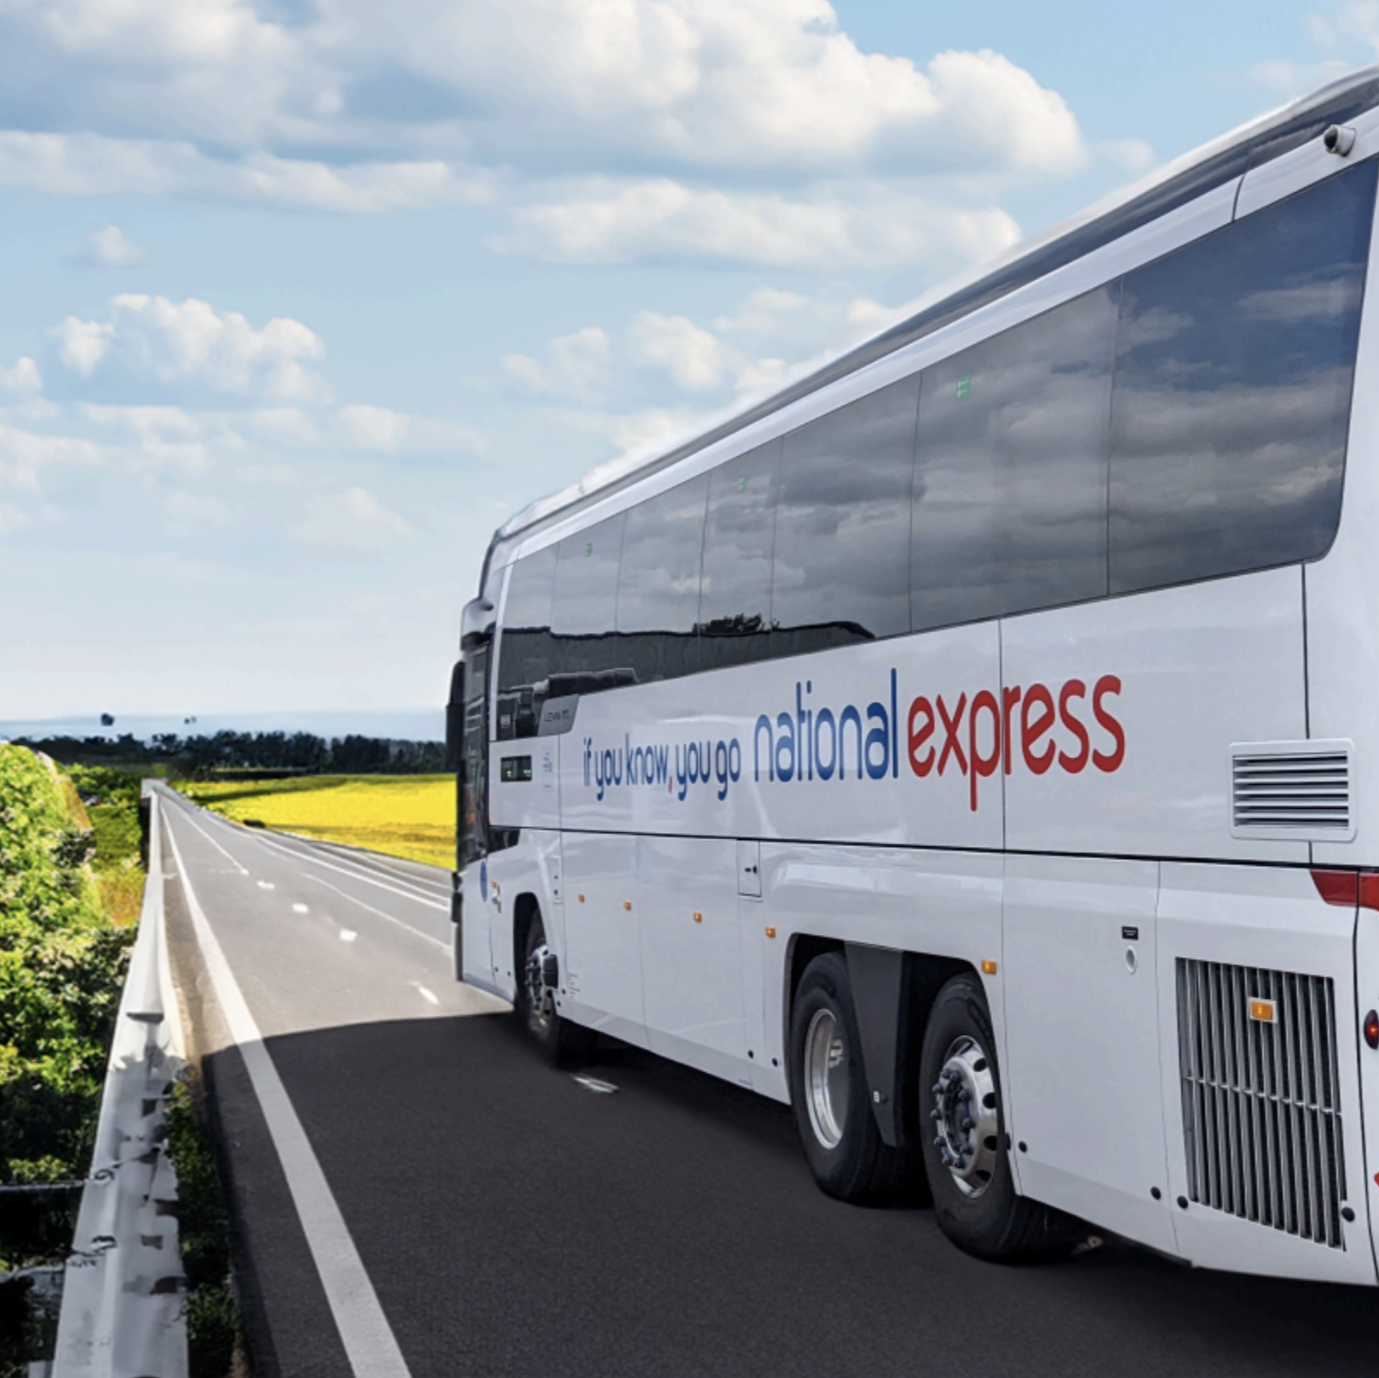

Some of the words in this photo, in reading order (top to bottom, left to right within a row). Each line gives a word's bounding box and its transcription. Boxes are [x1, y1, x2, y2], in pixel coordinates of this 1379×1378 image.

[582, 737, 593, 787] if
[594, 749, 624, 803] you
[675, 741, 713, 802] you
[714, 737, 742, 802] go
[753, 667, 900, 783] national
[908, 675, 1126, 812] express
